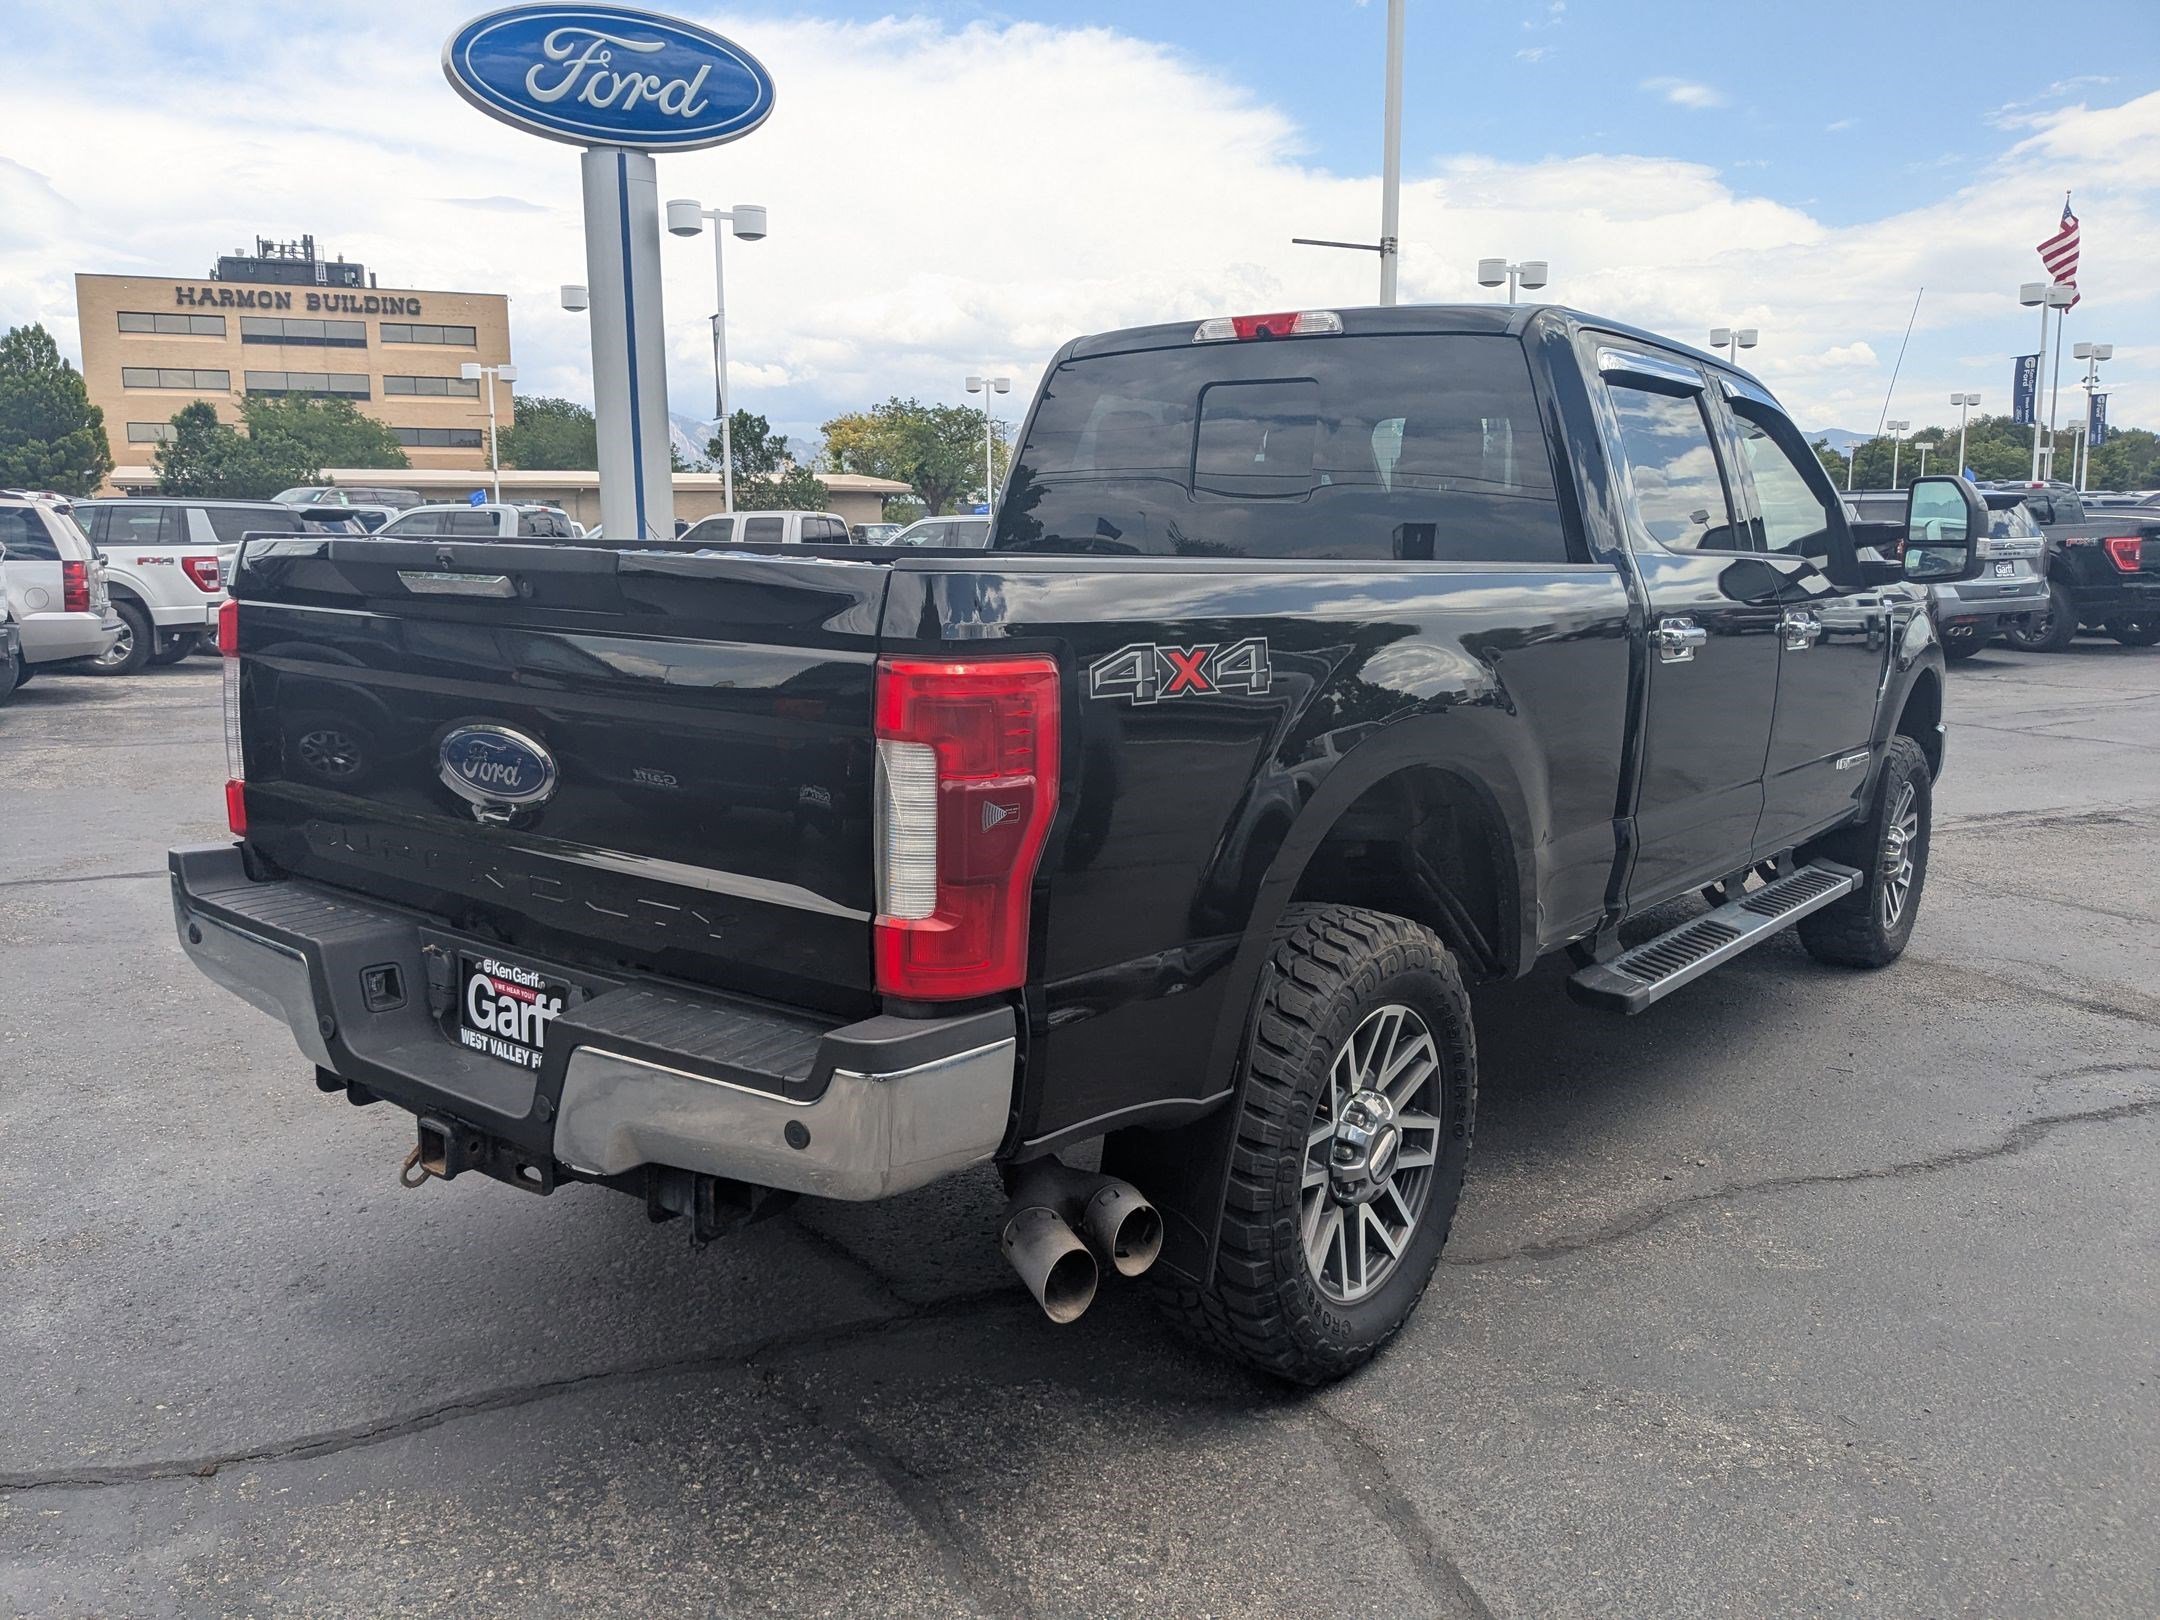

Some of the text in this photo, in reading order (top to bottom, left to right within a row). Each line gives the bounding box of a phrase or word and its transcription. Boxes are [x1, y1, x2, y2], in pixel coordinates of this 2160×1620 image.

[525, 27, 713, 118] Ford
[175, 286, 421, 316] HARMON BUILDING
[2022, 369, 2030, 387] Ford
[137, 557, 174, 566] FX4
[462, 740, 522, 786] Ford
[492, 960, 539, 988] Ken Garff
[507, 986, 521, 996] HEAR
[461, 1028, 489, 1051] WEST
[490, 1038, 530, 1066] VALLEY
